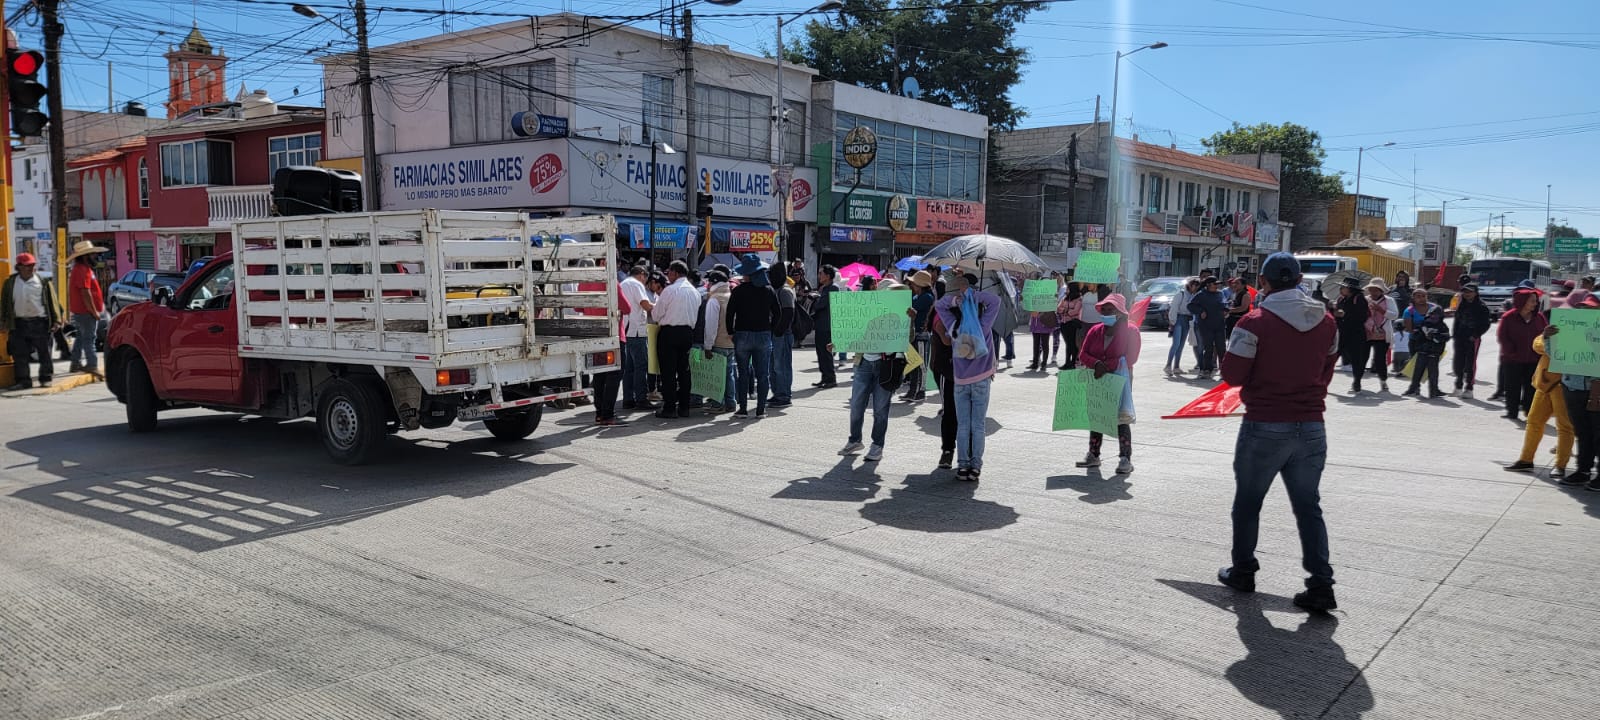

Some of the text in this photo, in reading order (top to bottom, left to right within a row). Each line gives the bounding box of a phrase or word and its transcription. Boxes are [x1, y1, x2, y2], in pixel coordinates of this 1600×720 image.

[845, 144, 870, 154] INDIO
[394, 162, 455, 189] FARMACIAS
[458, 156, 523, 184] SIMILARES
[534, 159, 557, 184] 75%
[712, 169, 772, 196] SIMILARE
[417, 189, 439, 199] MISMO
[440, 188, 459, 198] PERO
[460, 187, 476, 197] MAS
[660, 191, 688, 201] MISMO
[714, 195, 731, 205] MAS
[793, 183, 807, 201] 5%
[849, 207, 873, 220] EL CRUCERO
[891, 210, 909, 219] INDIO
[936, 220, 970, 231] TRUPER
[731, 238, 751, 247] LUNES
[750, 232, 773, 245] 25%
